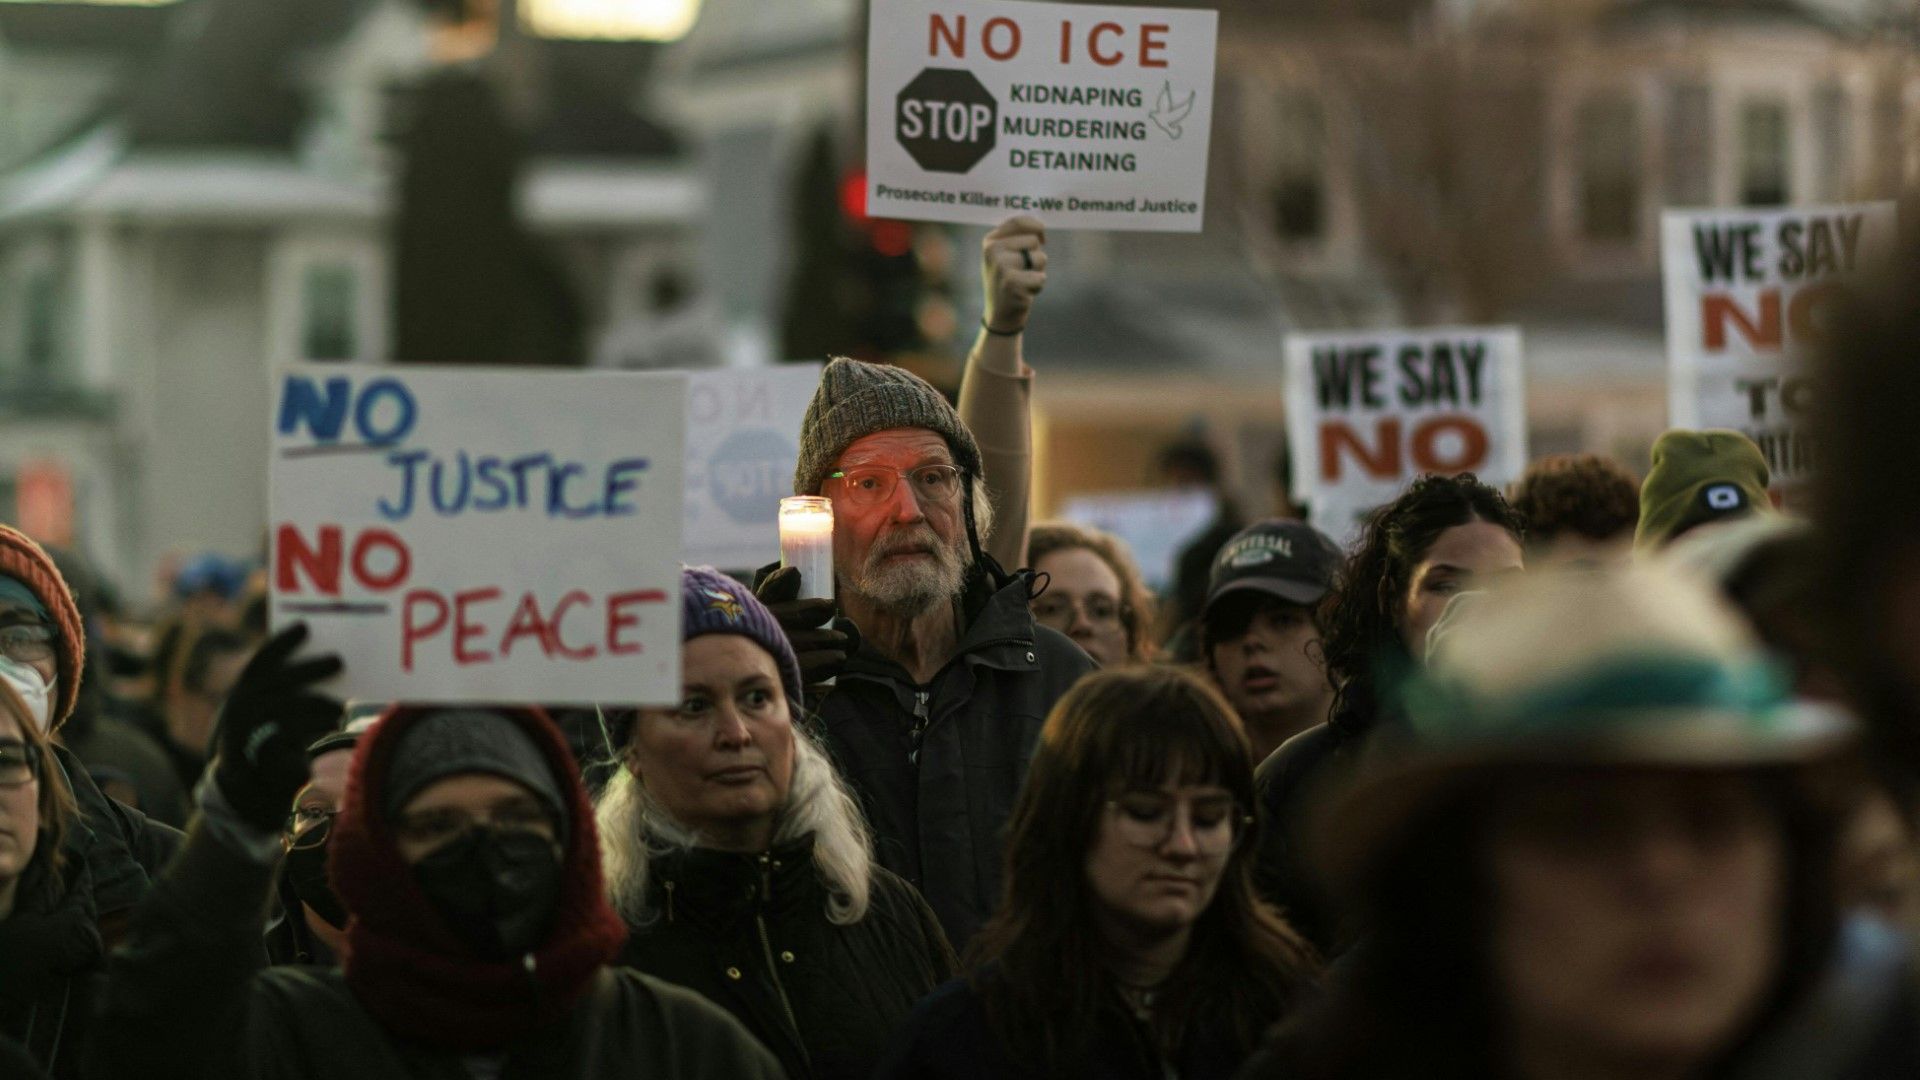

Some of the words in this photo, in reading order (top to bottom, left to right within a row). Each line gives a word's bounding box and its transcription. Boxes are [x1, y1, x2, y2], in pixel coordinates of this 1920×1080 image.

[929, 14, 1021, 61] NO
[1060, 20, 1170, 68] ICE
[901, 98, 993, 143] STOP
[1003, 116, 1146, 141] MURDERING
[1010, 84, 1143, 107] KIDNAPING
[1009, 149, 1136, 172] DETAINING
[876, 184, 955, 205] Prosecute
[960, 191, 999, 208] Killer
[1068, 197, 1135, 213] Demand
[1139, 198, 1197, 214] Justice
[1693, 222, 1765, 282] WE
[1778, 214, 1863, 281] SAY
[1312, 344, 1385, 410] WE
[1397, 342, 1486, 406] SAY
[278, 374, 417, 447] NO
[1319, 414, 1490, 484] NO
[376, 451, 651, 520] JUSTICE
[276, 523, 411, 595] NO
[401, 589, 667, 673] PEACE
